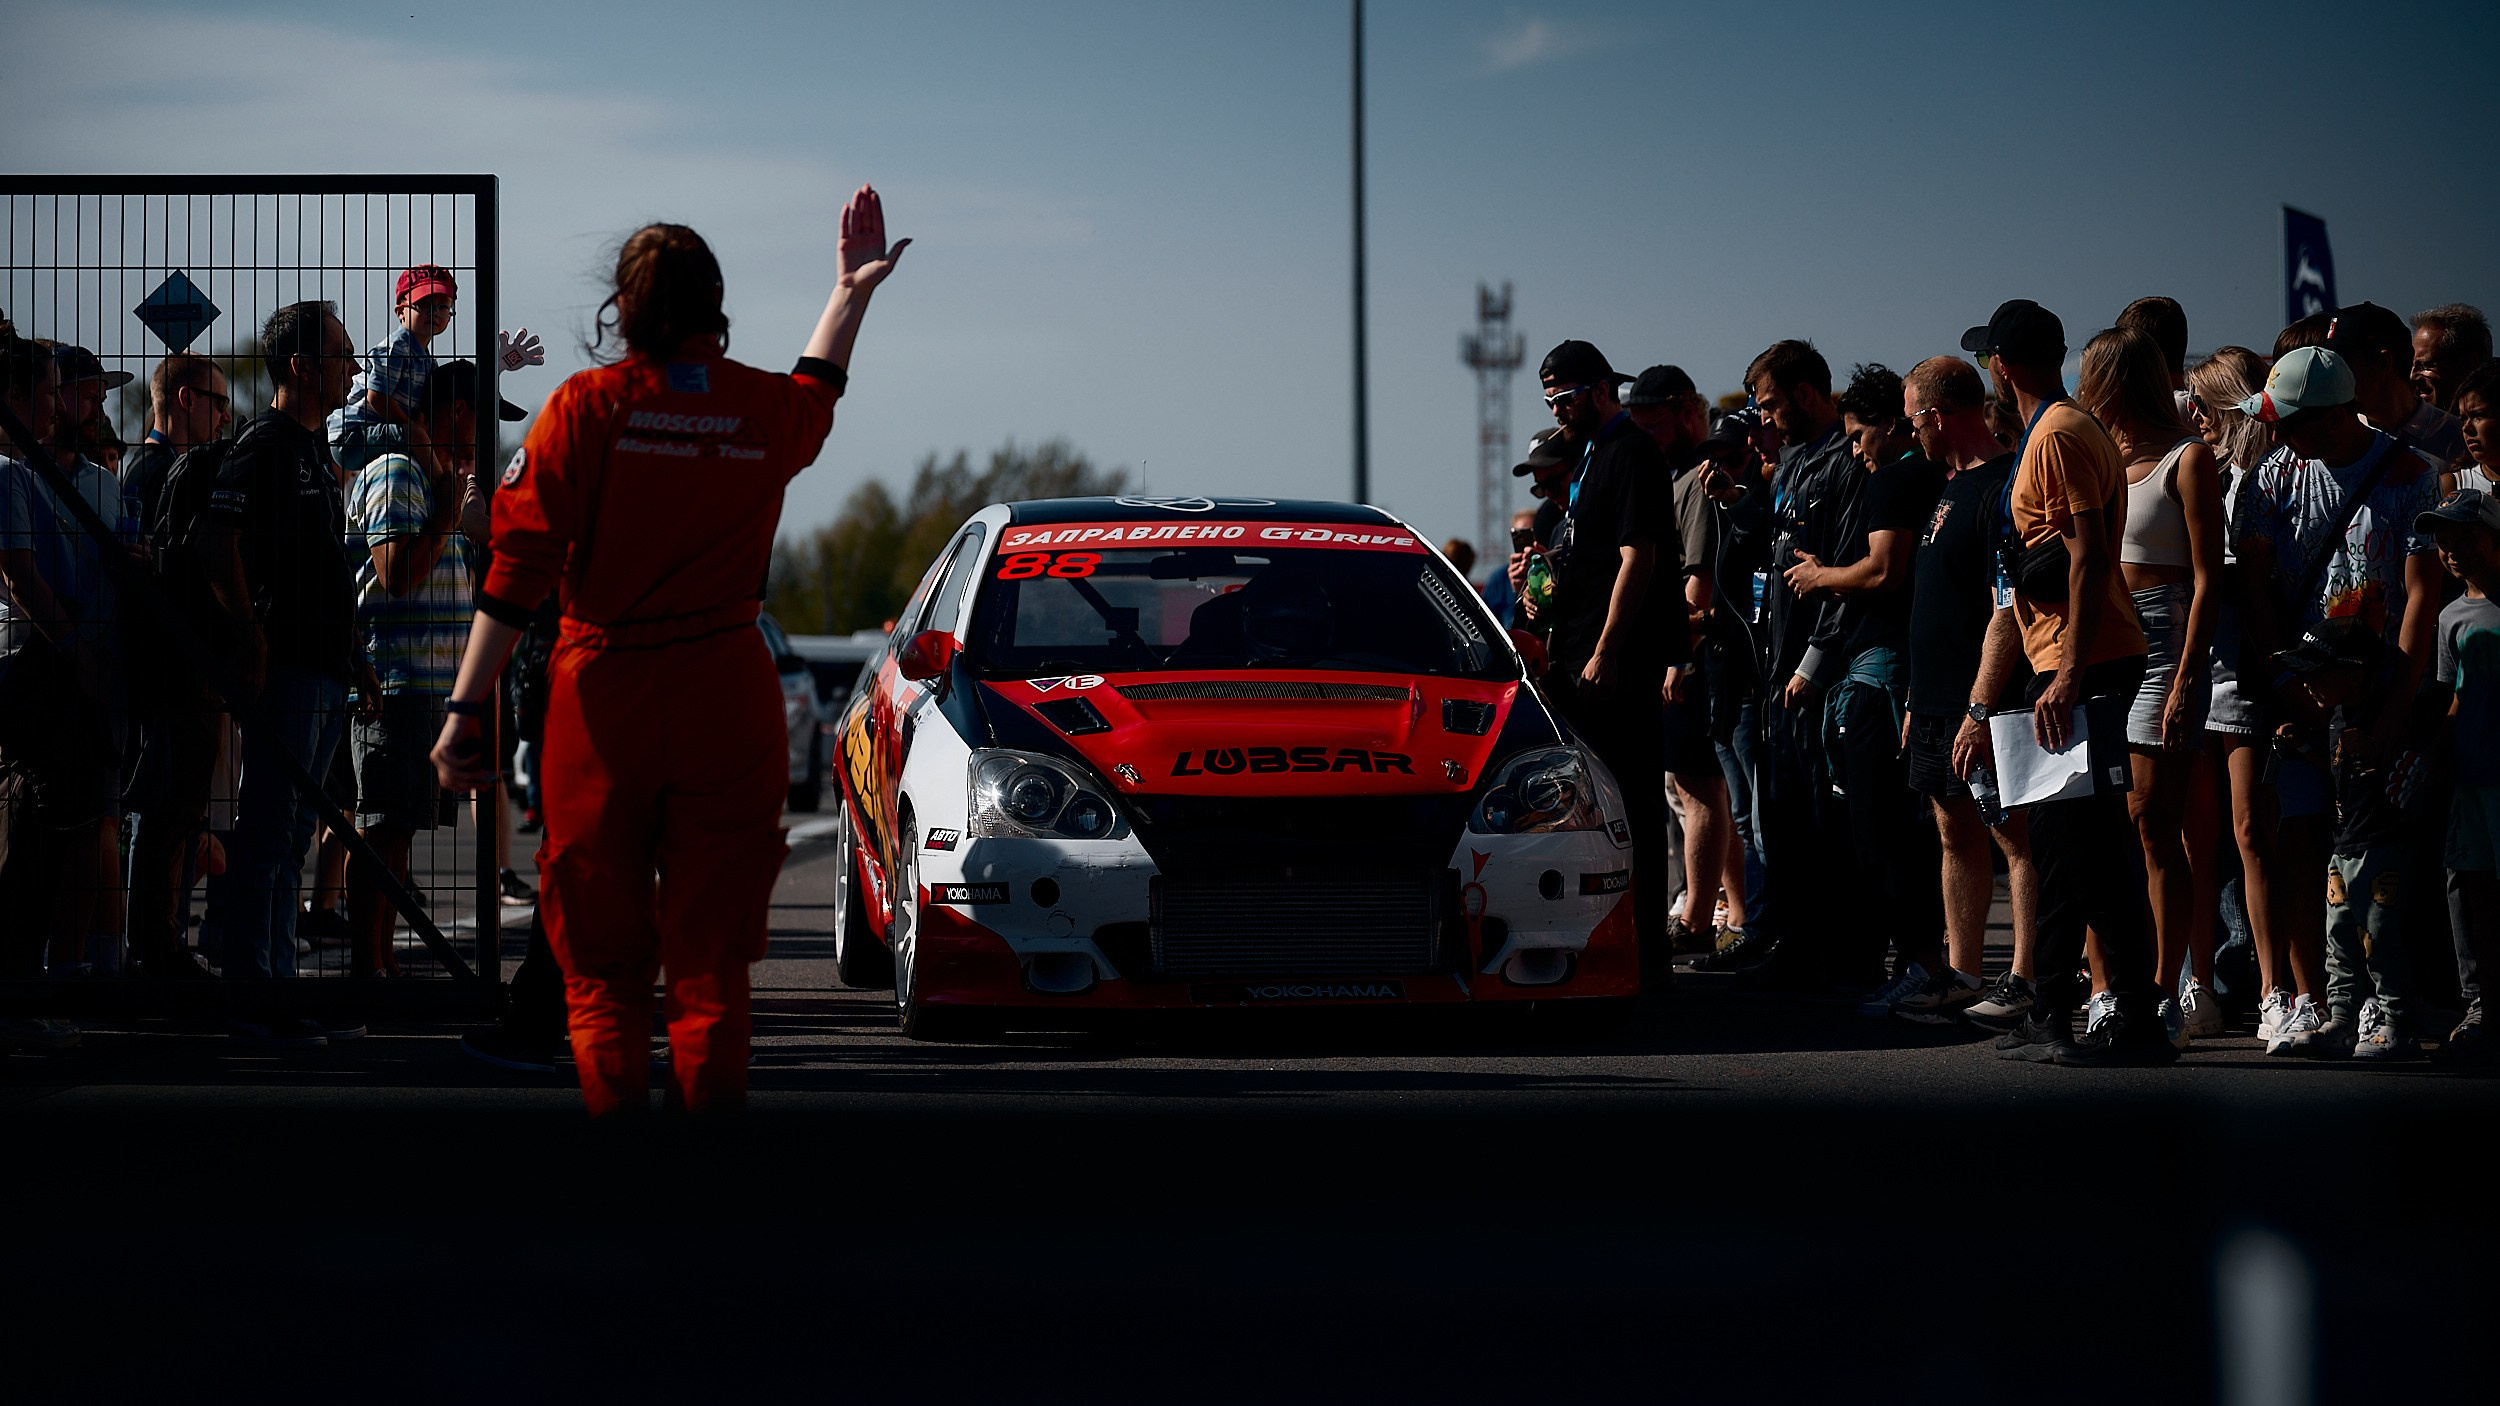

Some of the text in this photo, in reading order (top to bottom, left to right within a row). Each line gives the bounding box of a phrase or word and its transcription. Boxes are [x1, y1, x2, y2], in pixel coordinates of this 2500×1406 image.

[627, 410, 741, 433] MOSCOW
[615, 437, 766, 460] Marshals Team
[1006, 526, 1246, 546] ЗАПРАВЛЕНО
[996, 552, 1103, 580] 88
[1169, 746, 1417, 777] LUBSAR
[947, 887, 1002, 900] YOKOHAMA
[1246, 984, 1397, 998] YOKOHAMA
